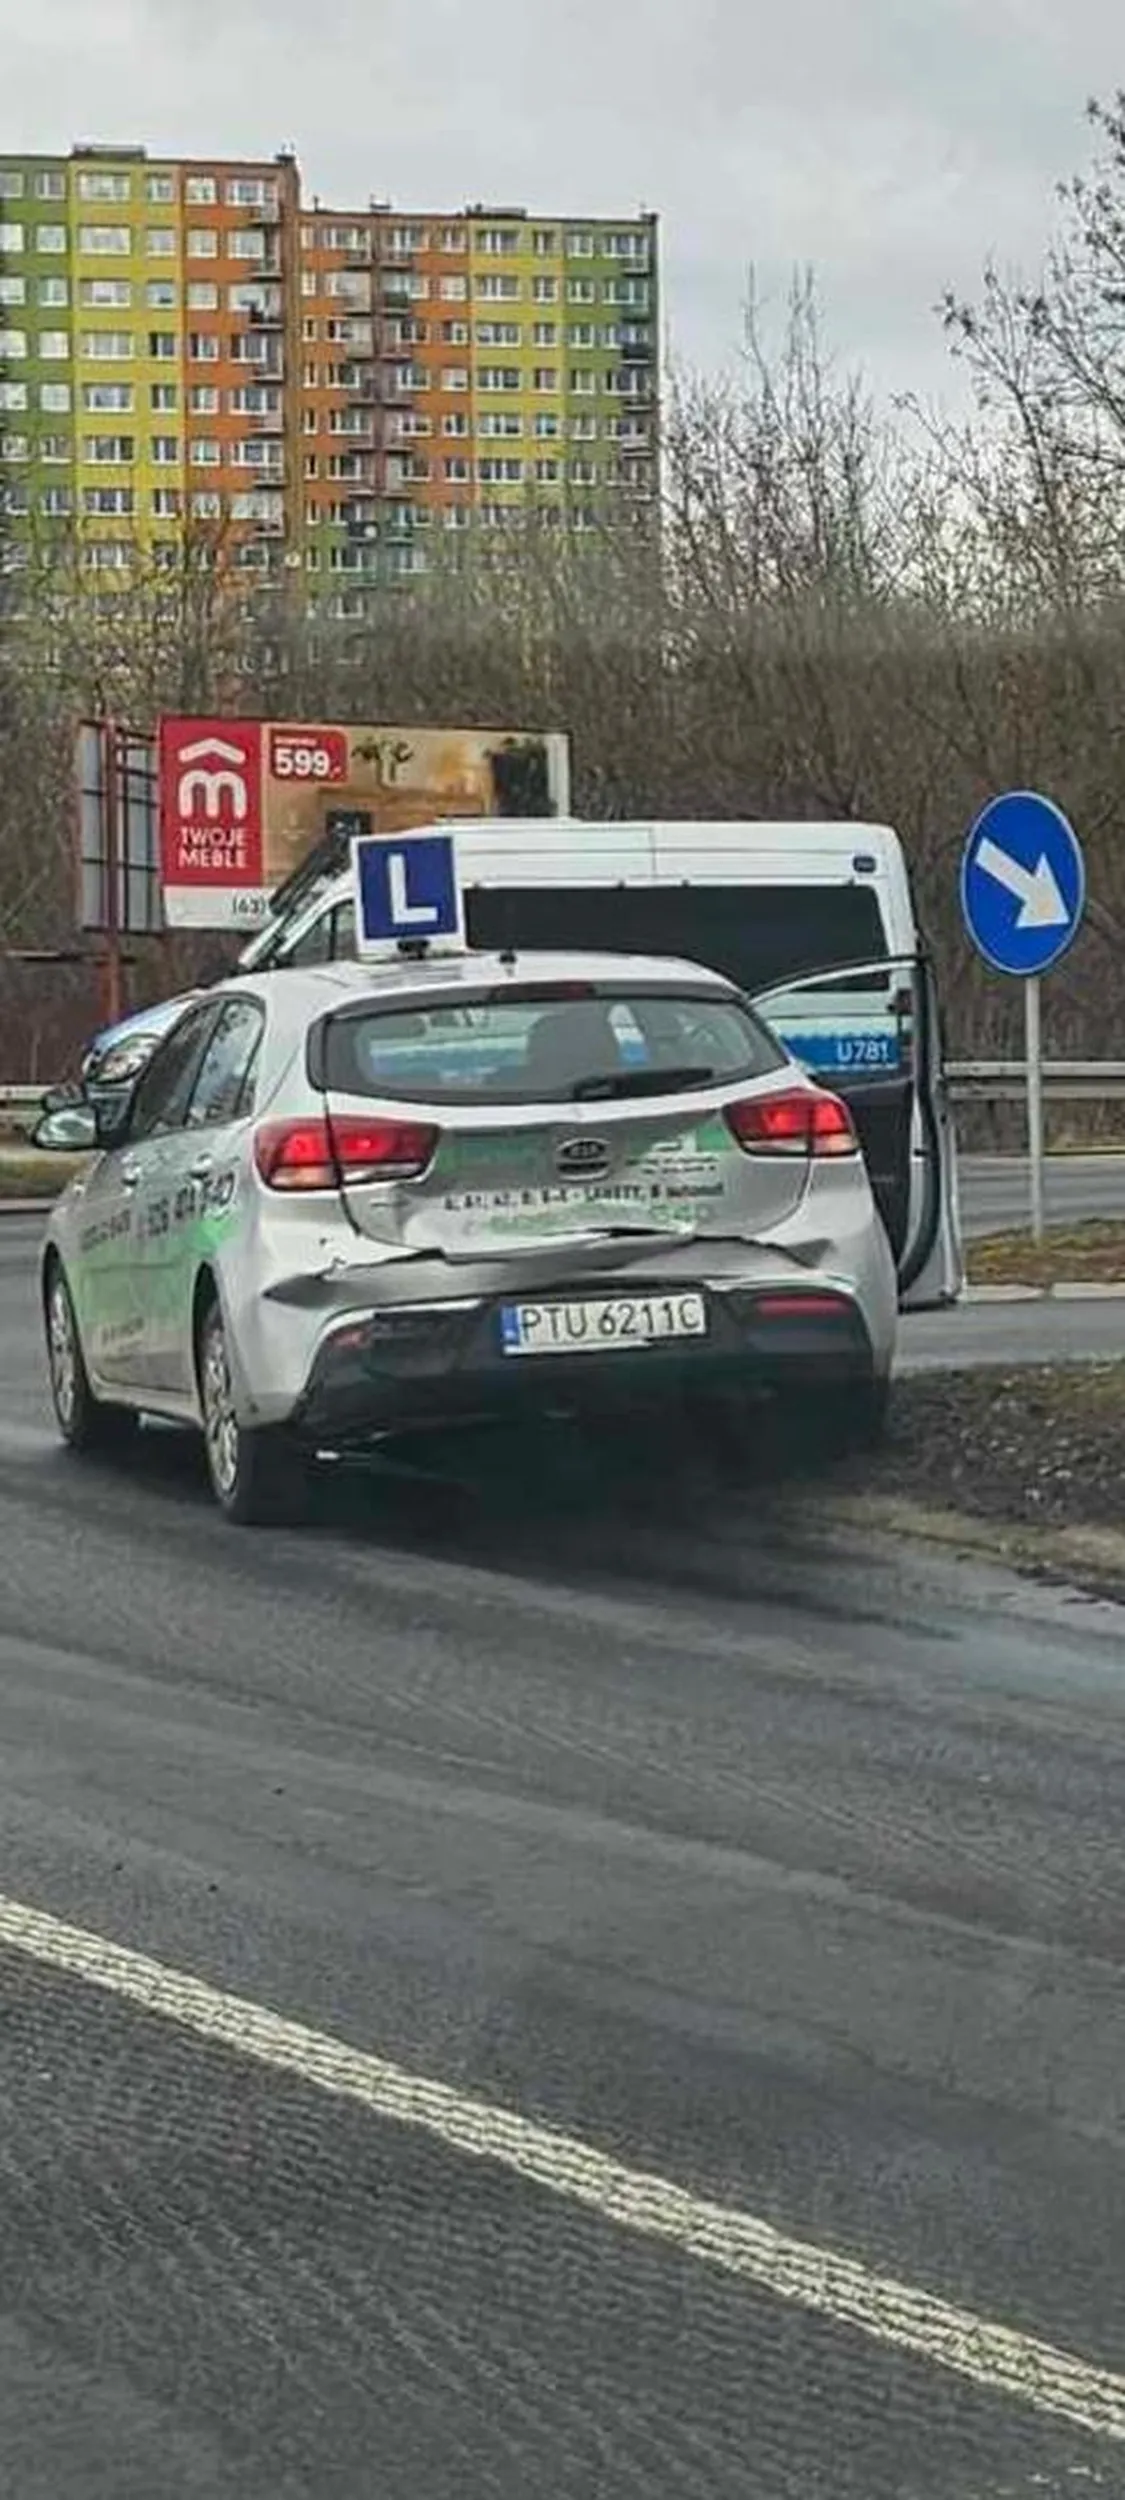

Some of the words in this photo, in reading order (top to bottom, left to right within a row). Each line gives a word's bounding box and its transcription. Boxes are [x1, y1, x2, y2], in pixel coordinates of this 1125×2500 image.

[180, 827, 247, 847] TWOJE
[179, 849, 248, 869] MEBLE
[387, 853, 438, 925] L
[837, 1040, 890, 1062] U781
[521, 1305, 588, 1342] PTU
[599, 1297, 701, 1336] 6211C
